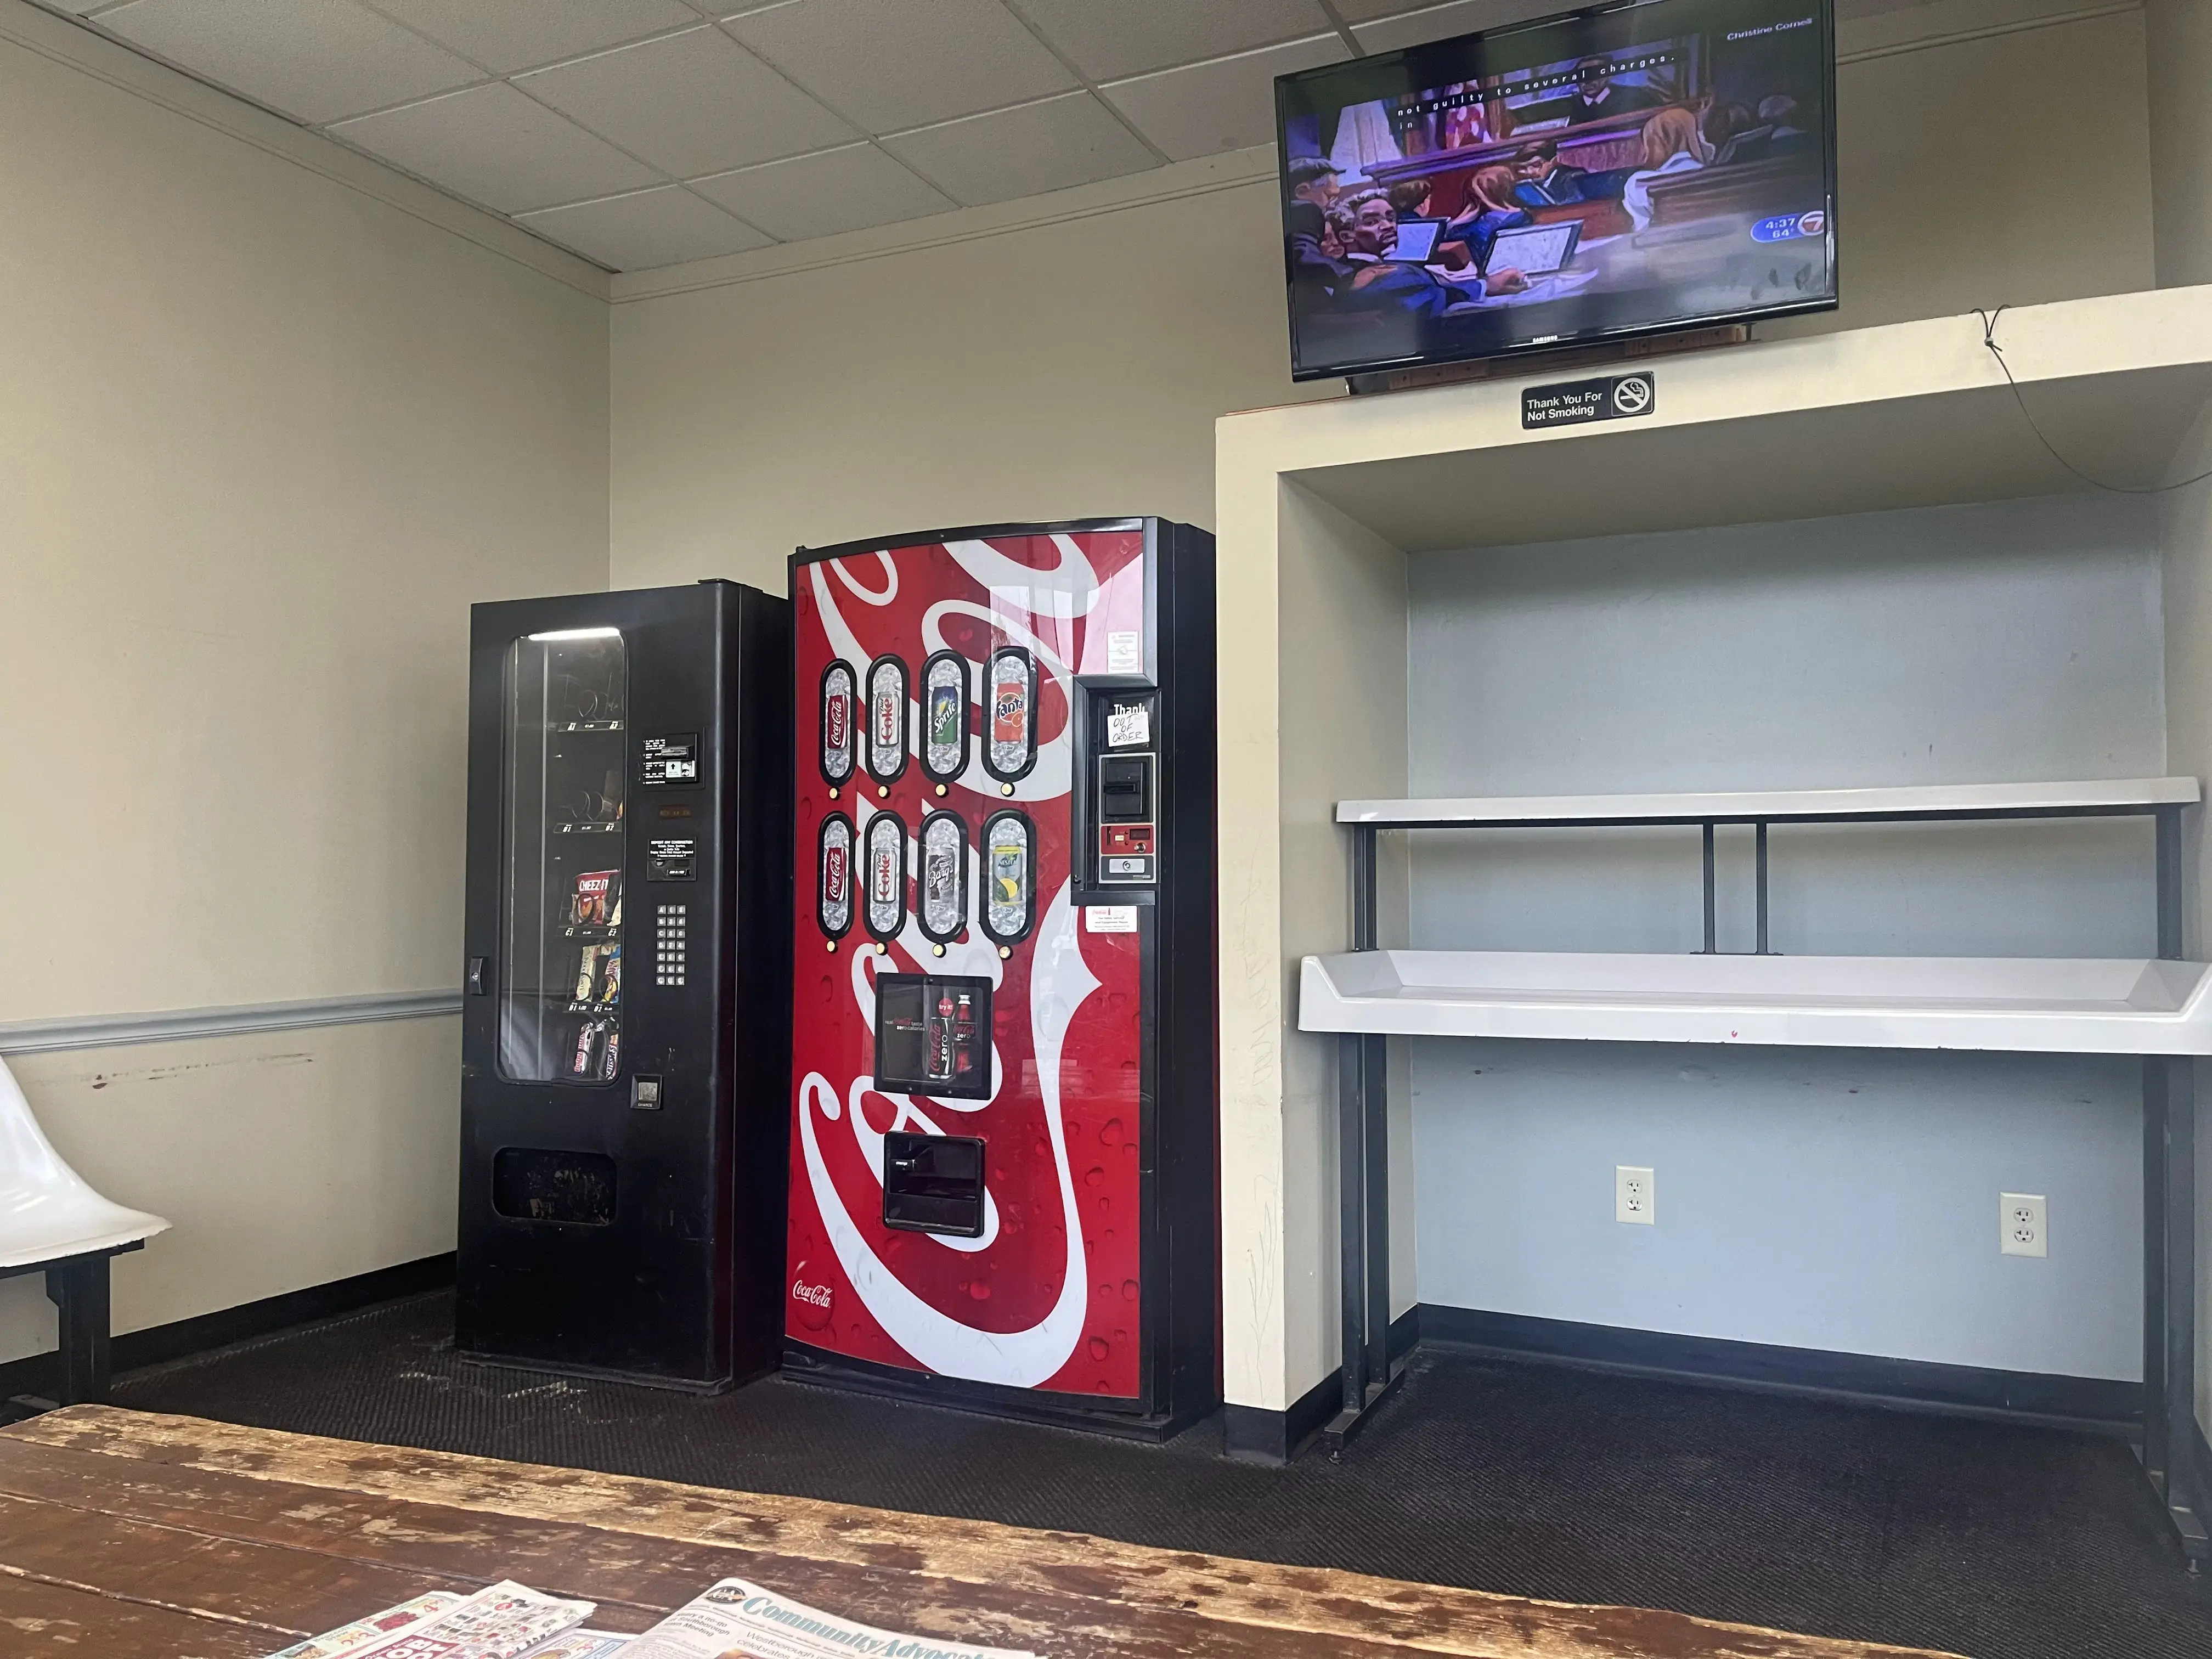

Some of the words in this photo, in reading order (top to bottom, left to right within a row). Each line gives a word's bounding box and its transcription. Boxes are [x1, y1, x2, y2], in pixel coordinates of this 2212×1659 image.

[1397, 105, 1420, 116] not
[1432, 92, 1483, 110] guilty
[1497, 87, 1512, 95] to
[1524, 70, 1585, 91] several
[1765, 217, 1796, 229] 4:37
[1527, 396, 1560, 410] Thank
[1562, 394, 1582, 405] You
[1584, 391, 1602, 402] For
[1527, 411, 1546, 421] Not
[1548, 405, 1595, 418] Smoking
[881, 697, 893, 741] Coke
[934, 702, 957, 733] Sprite
[1112, 731, 1144, 743] ORDER
[1121, 723, 1133, 733] OF
[878, 854, 890, 897] Coke
[792, 1279, 833, 1308] Coca-Cola
[682, 1622, 714, 1637] Meeting
[737, 1639, 791, 1659] celebrates
[746, 1630, 815, 1658] Westborough
